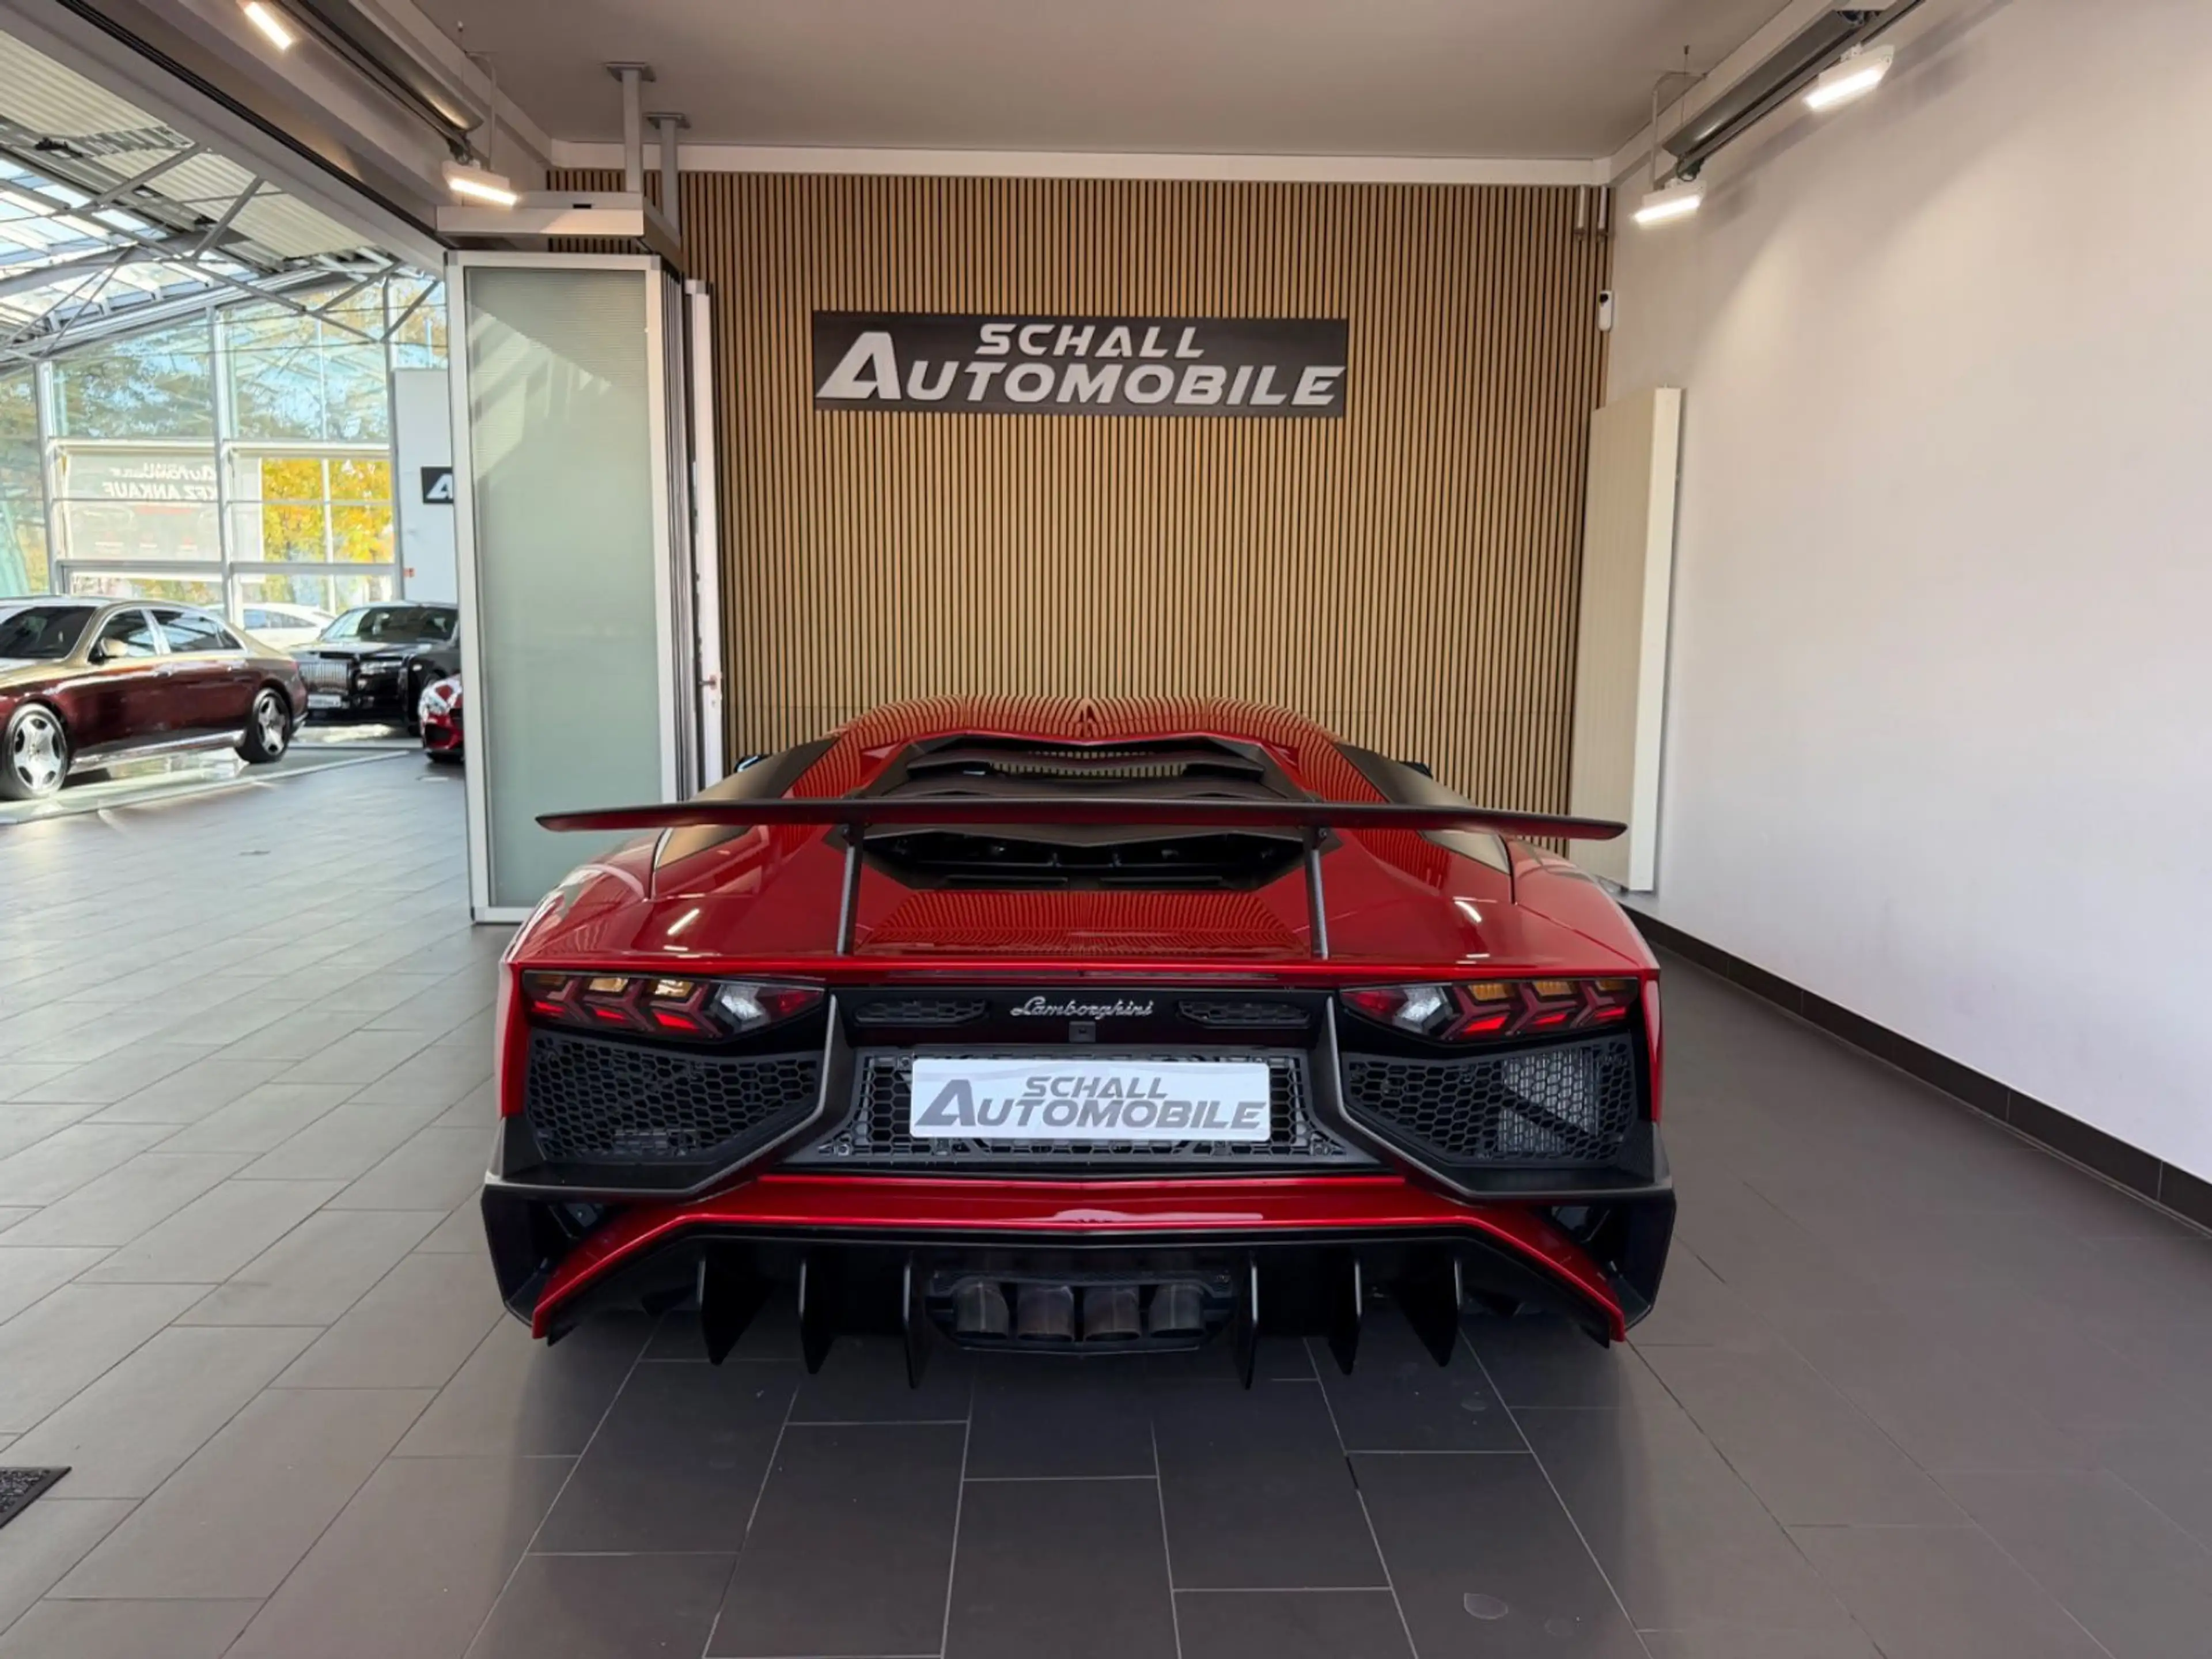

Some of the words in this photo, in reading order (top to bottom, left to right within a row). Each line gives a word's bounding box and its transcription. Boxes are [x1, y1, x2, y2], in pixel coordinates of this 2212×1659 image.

[975, 323, 1205, 358] SCHALL
[816, 331, 1346, 406] AUTOMOBILE
[1010, 996, 1154, 1020] Lamborghini
[915, 1080, 1266, 1128] AUTOMOBILE
[1022, 1076, 1168, 1099] SCHALL
